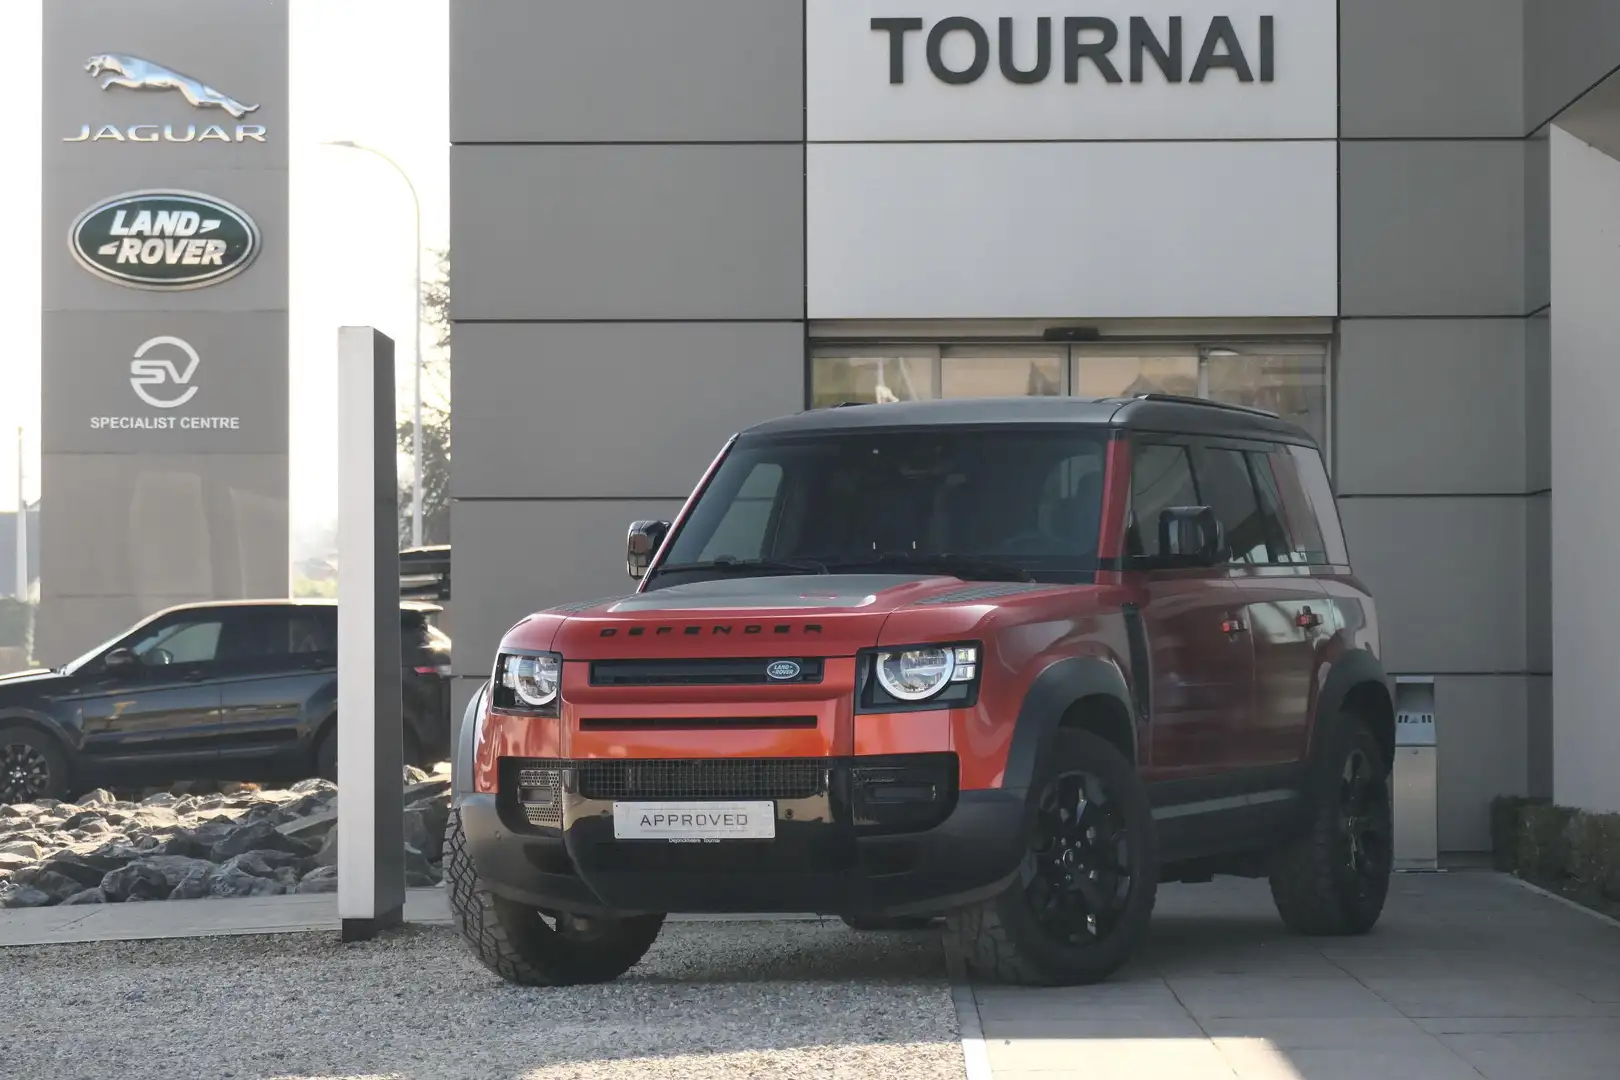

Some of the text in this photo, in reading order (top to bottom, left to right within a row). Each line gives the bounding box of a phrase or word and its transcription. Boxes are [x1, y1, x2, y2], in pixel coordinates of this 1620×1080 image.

[870, 16, 1274, 84] TOURNAI
[62, 124, 267, 142] JAGUAR
[109, 210, 200, 236] LAND
[117, 238, 227, 265] ROVER
[90, 416, 240, 430] SPECIALIST CENTRE
[600, 624, 823, 638] DEFENDER
[640, 814, 748, 826] APPROVED
